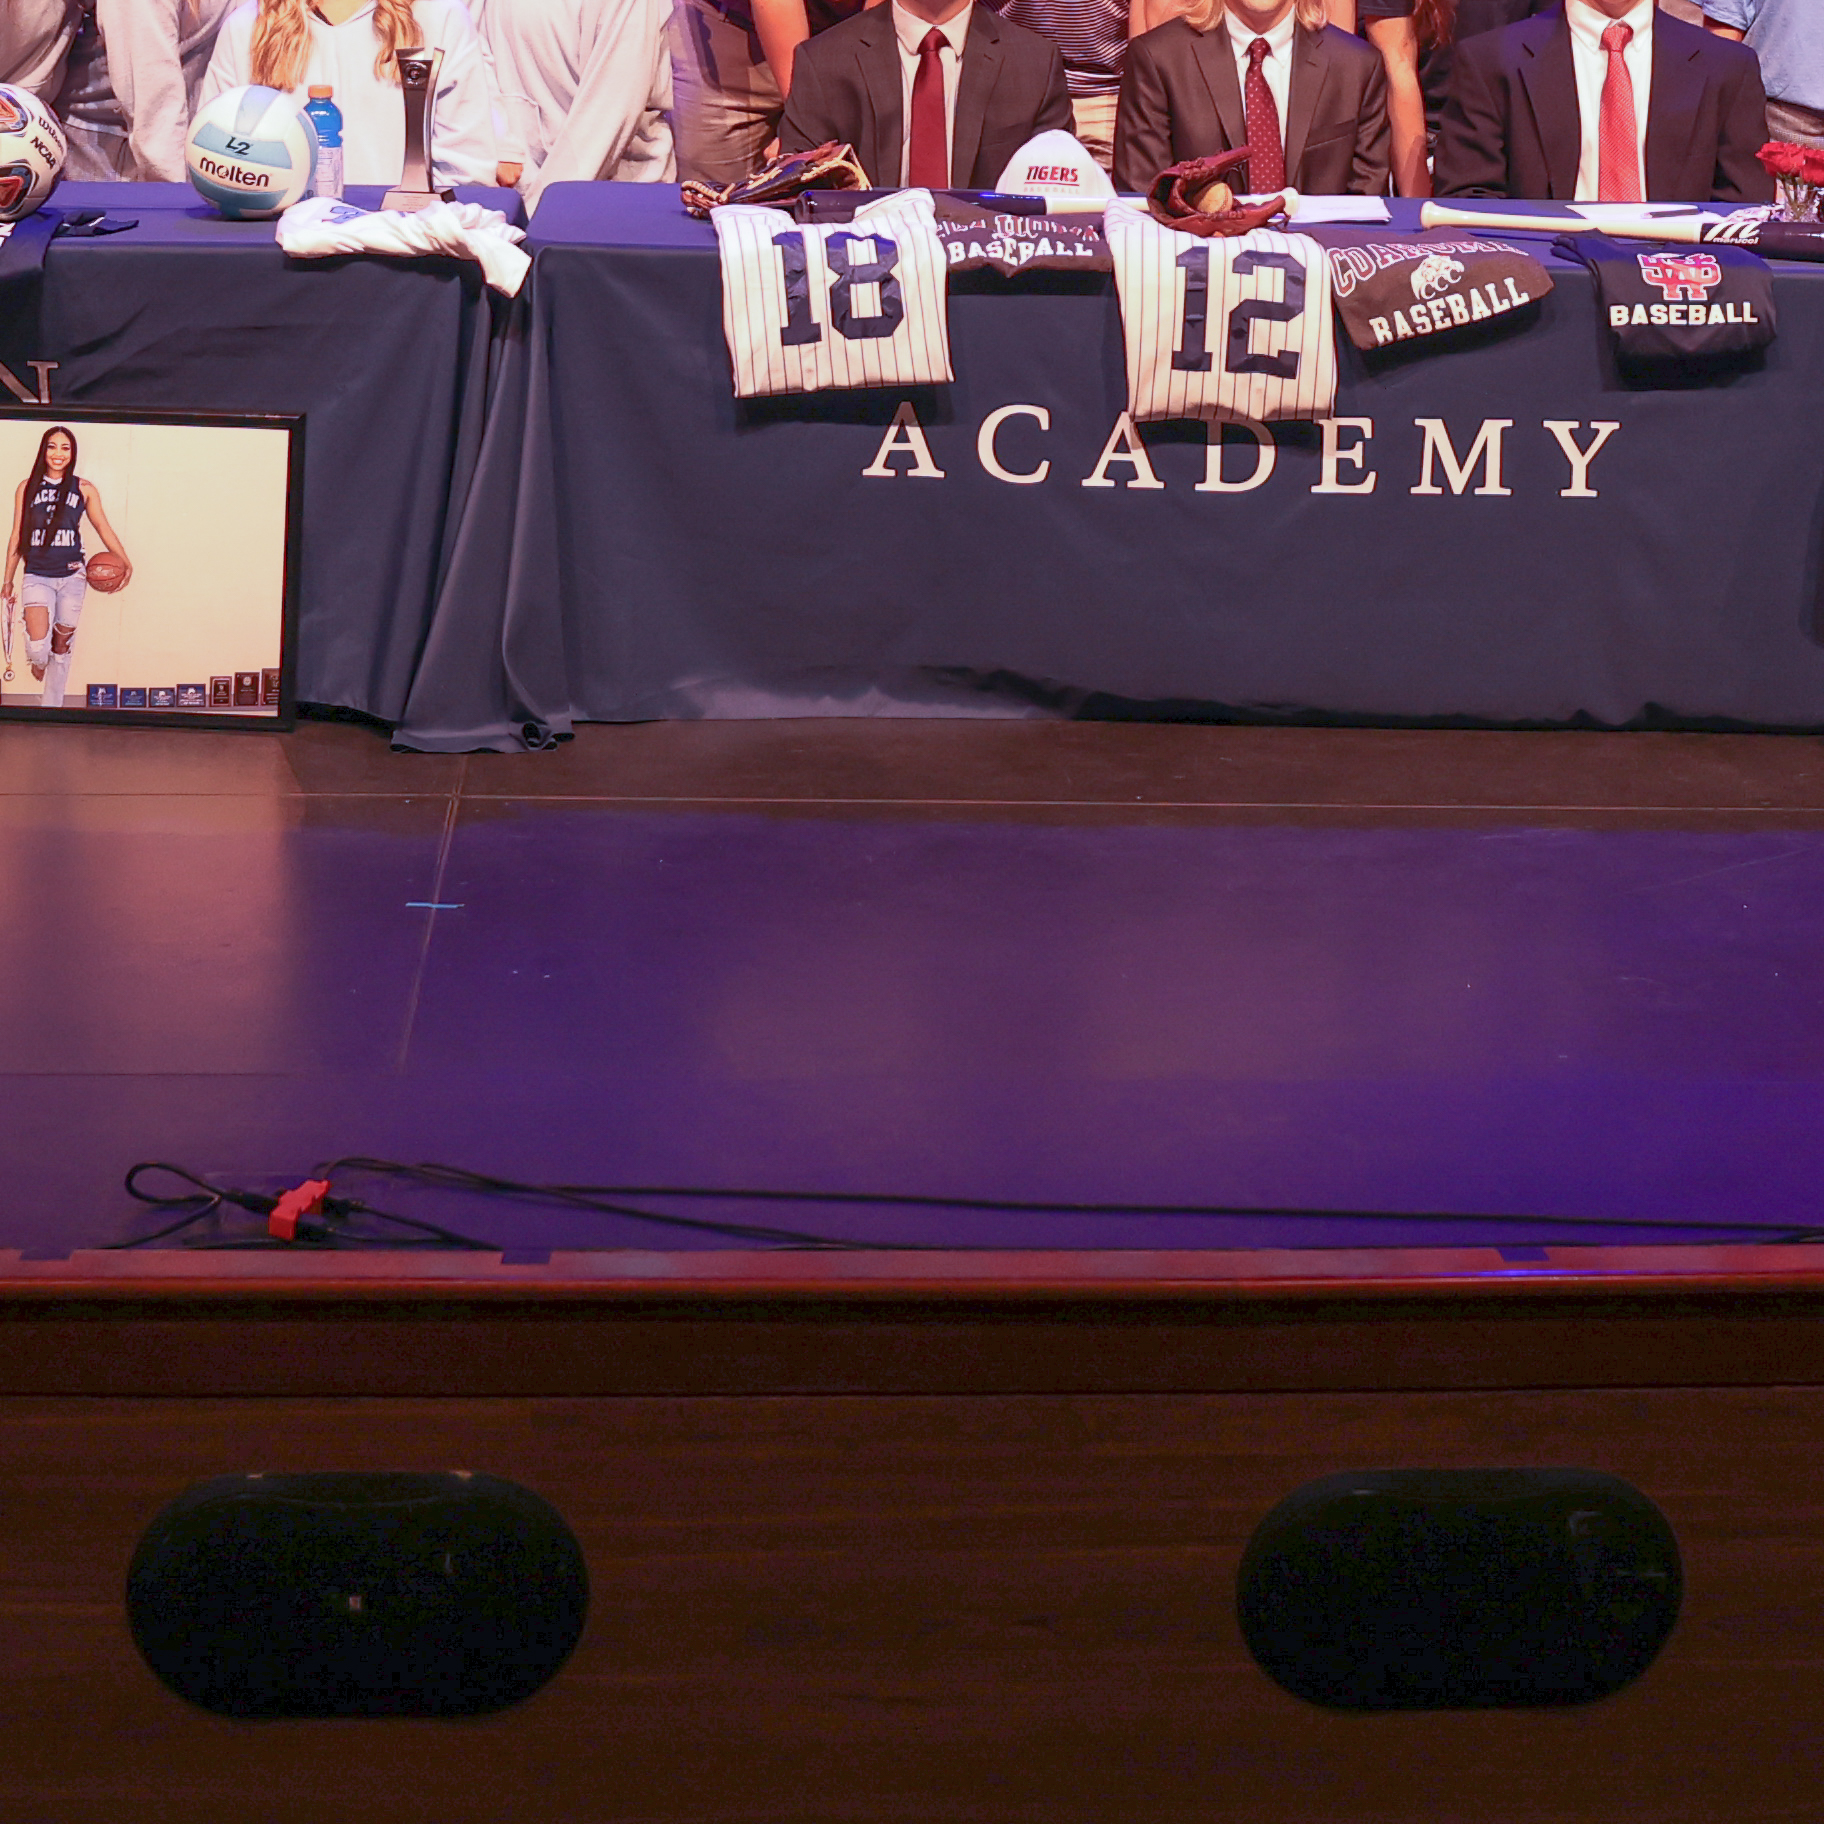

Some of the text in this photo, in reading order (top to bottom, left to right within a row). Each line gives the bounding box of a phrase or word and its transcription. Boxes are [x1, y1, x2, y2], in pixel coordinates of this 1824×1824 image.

[30, 136, 57, 170] NCAA
[199, 157, 270, 187] molten
[1026, 165, 1079, 183] TIGERS
[947, 237, 1094, 267] BASEBALL
[772, 230, 905, 346] 18
[1171, 244, 1307, 379] 12
[1369, 277, 1530, 346] BASEBALL
[1609, 302, 1759, 326] BASEBALL
[862, 401, 1620, 498] ACADEMY
